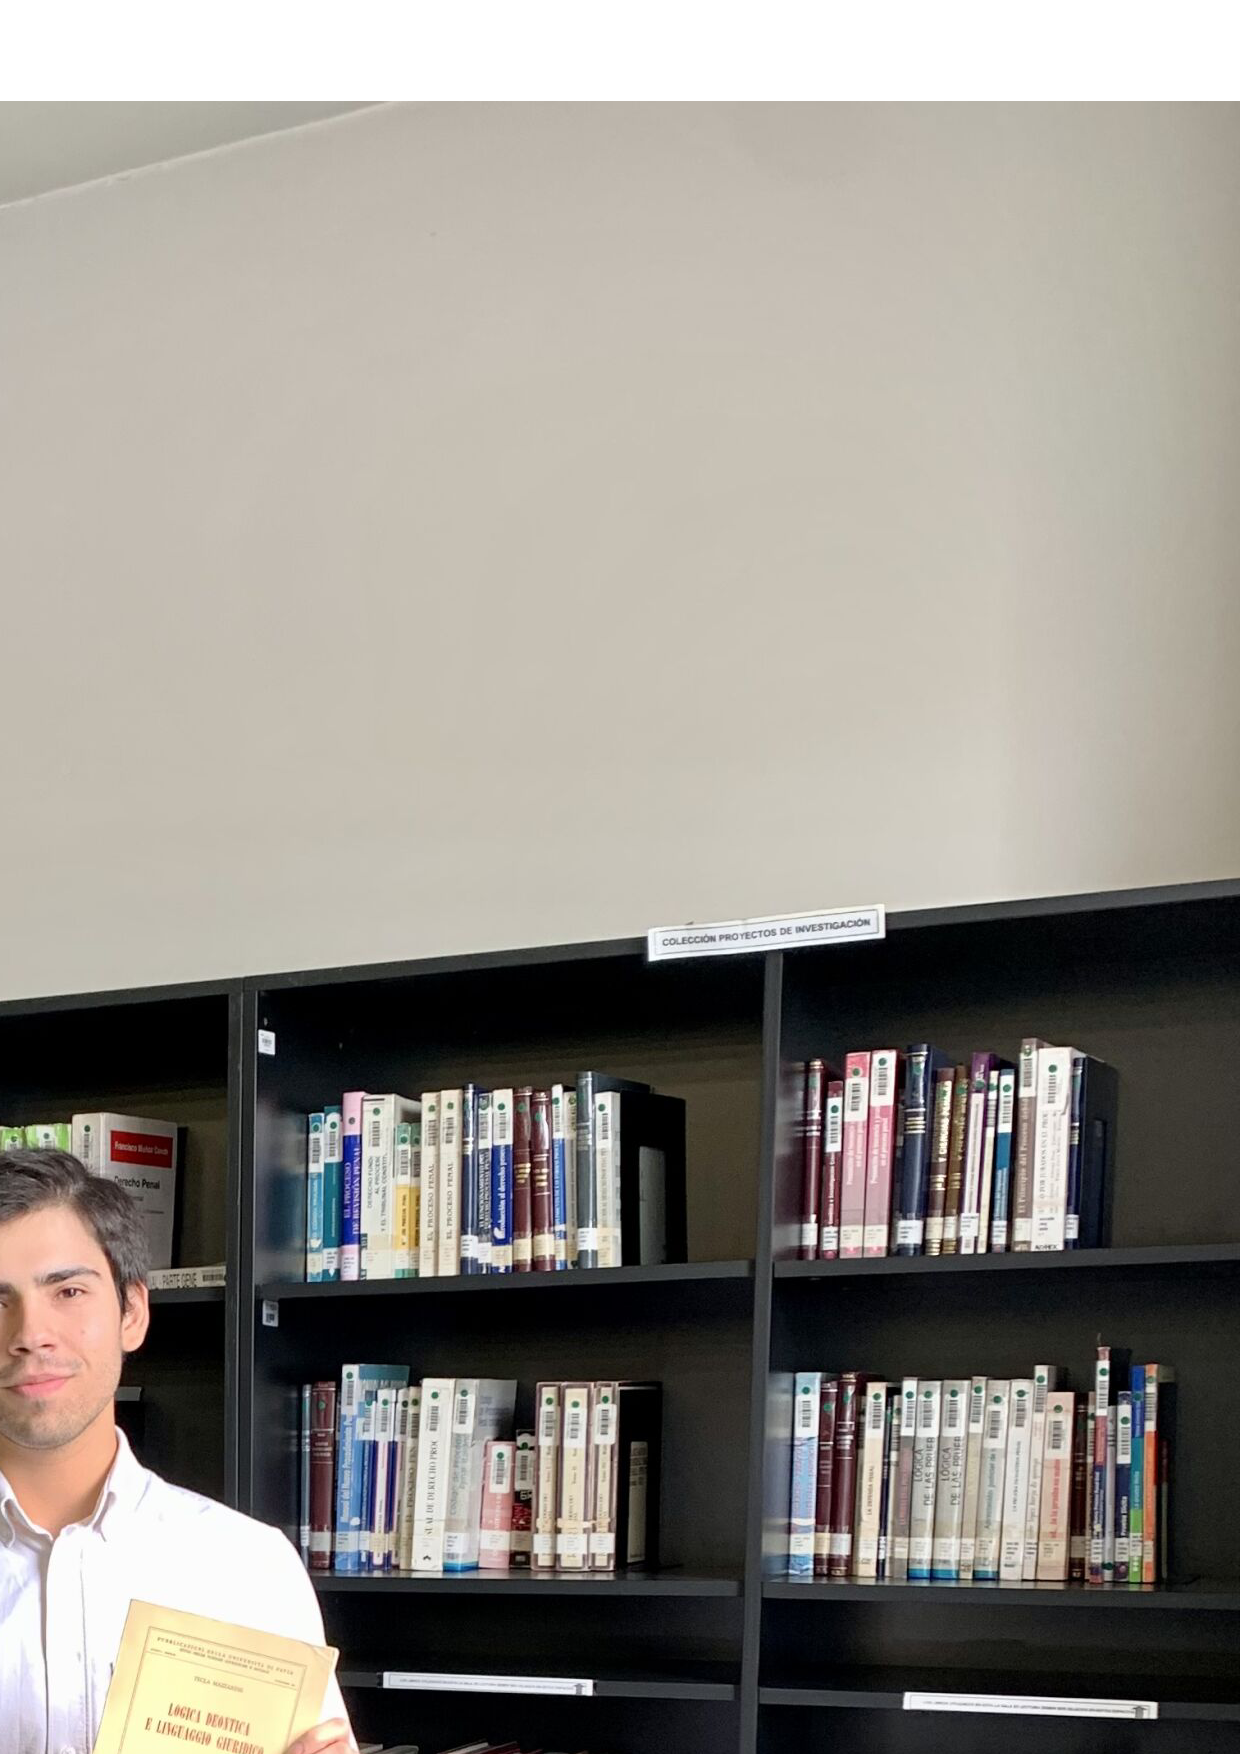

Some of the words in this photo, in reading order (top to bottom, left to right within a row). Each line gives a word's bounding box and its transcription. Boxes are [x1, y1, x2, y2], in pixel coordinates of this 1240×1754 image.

[662, 934, 716, 947] COLECCIÓN
[719, 928, 777, 942] PROYECTOS
[780, 926, 792, 935] DE
[795, 918, 871, 934] INVESTIGACIÓN
[114, 1141, 137, 1151] Francisco
[1020, 1122, 1029, 1151] Proceso
[115, 1176, 141, 1188] Derecho
[142, 1178, 160, 1189] Penal
[344, 1206, 350, 1218] EL
[427, 1231, 434, 1241] EL
[446, 1230, 452, 1239] EL
[342, 1427, 353, 1468] Procedimiento
[914, 1449, 924, 1482] LÓGICA
[940, 1447, 951, 1481] LÓGICA
[343, 1470, 351, 1489] Nuevo
[925, 1472, 934, 1489] LAS
[952, 1472, 961, 1488] LAS
[342, 1490, 350, 1499] del
[341, 1501, 350, 1523] Manual
[1119, 1515, 1128, 1536] Prueba
[168, 1703, 201, 1723] LOGICA
[205, 1713, 251, 1736] DEONTICA
[145, 1717, 152, 1731] E
[156, 1720, 211, 1746] LINGUAGGIO
